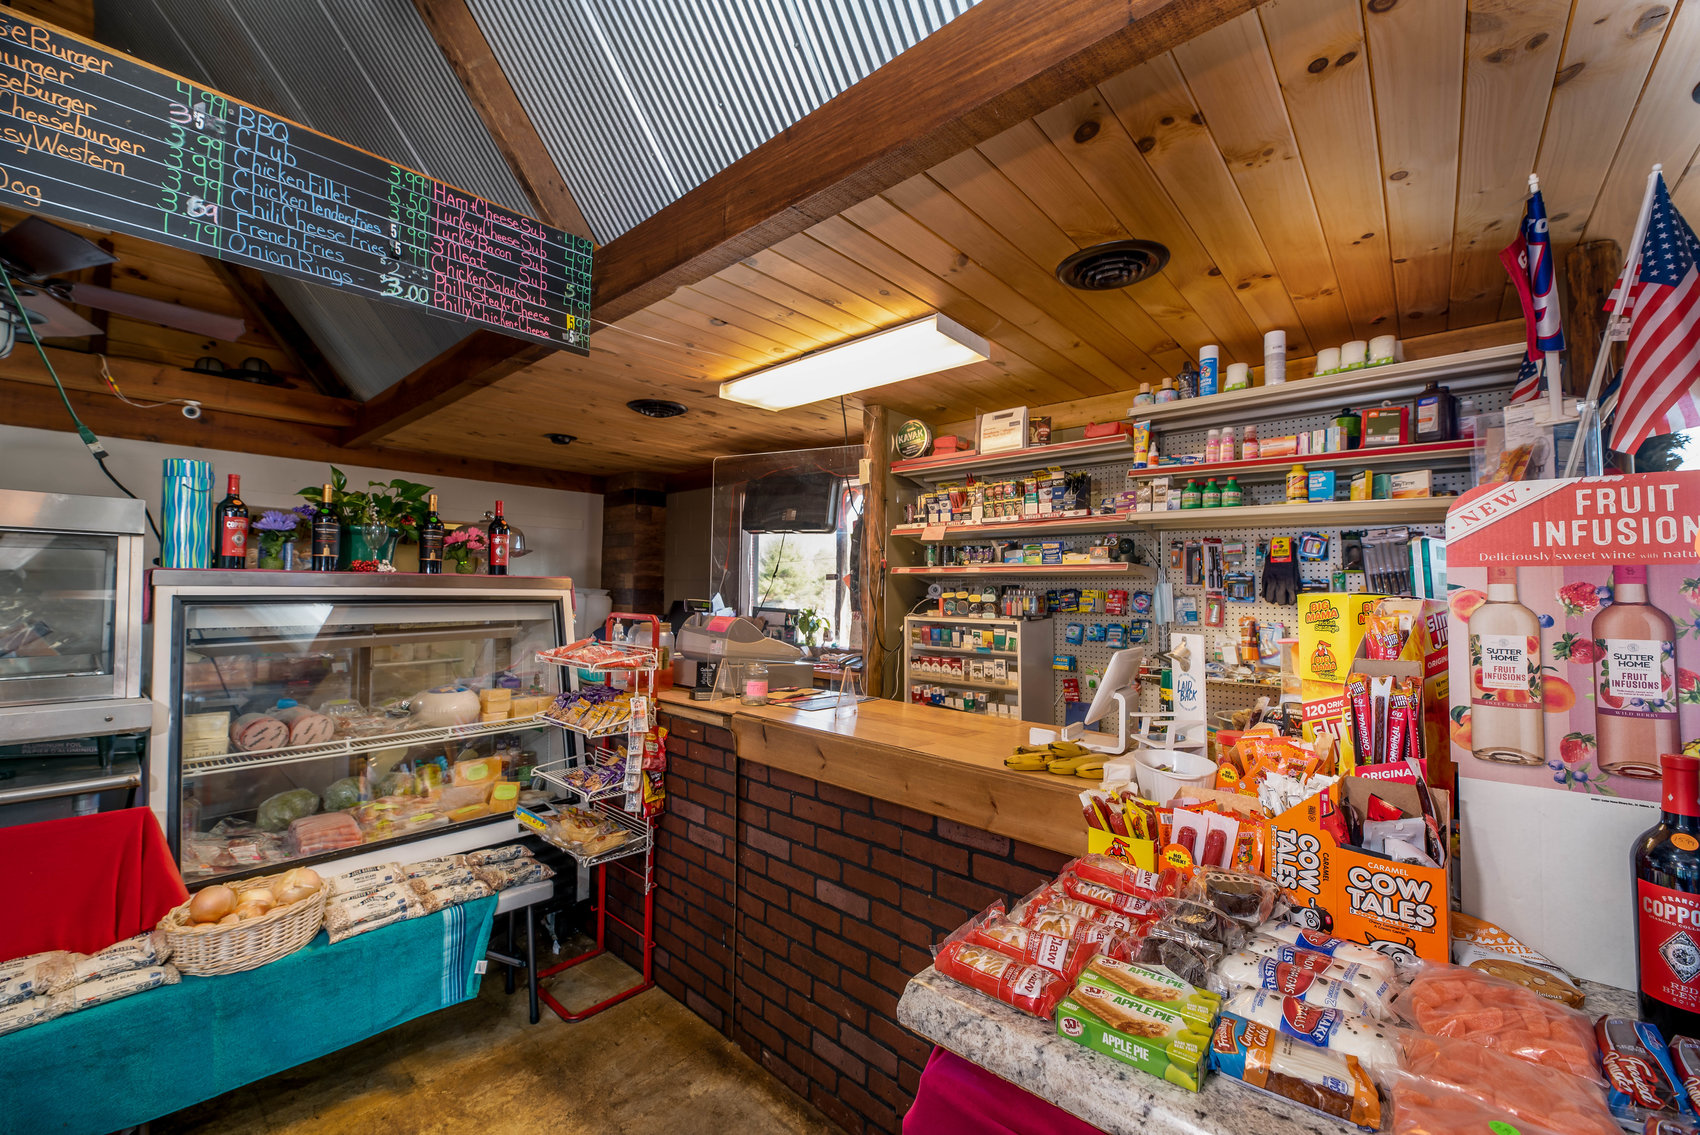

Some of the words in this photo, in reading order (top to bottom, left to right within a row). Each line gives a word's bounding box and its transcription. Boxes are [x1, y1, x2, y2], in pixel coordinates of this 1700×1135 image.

[239, 106, 289, 144] BBQ
[234, 148, 305, 192] Chicken
[388, 166, 425, 195] 3.99
[232, 169, 308, 211] Chicken
[231, 190, 280, 224] Chili
[281, 204, 347, 244] Cheese
[237, 212, 298, 249] French
[303, 233, 345, 263] Fries
[521, 219, 546, 241] Sub
[432, 218, 477, 254] Turkey
[478, 235, 512, 261] Bacon
[521, 252, 548, 273] Sub
[521, 234, 547, 258] Sub
[228, 233, 293, 268] Onion
[299, 251, 353, 287] Rings
[448, 242, 488, 270] Meat
[519, 266, 548, 290] Sub
[434, 273, 472, 300] Philly
[485, 271, 516, 296] Salad
[517, 283, 547, 307] Sub
[434, 291, 471, 323] Philly
[898, 429, 924, 445] KAYAK
[1459, 488, 1518, 527] NEW
[1575, 483, 1680, 516] FRUIT
[1479, 551, 1551, 563] Deliciously
[1555, 551, 1596, 561] sweet
[1601, 550, 1636, 560] wine
[1305, 609, 1339, 623] MAMA
[1310, 600, 1330, 612] BIG
[1363, 601, 1374, 613] BI
[1315, 655, 1330, 664] BIG
[1486, 647, 1523, 656] SUTTER
[1490, 654, 1519, 662] HOME
[1613, 652, 1654, 662] SUTTER
[1311, 662, 1337, 672] MAMA
[1494, 665, 1516, 673] FRUIT
[1618, 661, 1651, 669] HOME
[1621, 671, 1648, 681] FRUIT
[1484, 672, 1527, 682] INFUSIONS
[1611, 679, 1660, 690] INFUSIONS
[1180, 689, 1198, 702] BACK
[1305, 704, 1327, 717] 120
[1361, 711, 1371, 751] ORIGINAL
[1389, 726, 1400, 763] ORIGINAL
[1361, 767, 1415, 779] ORIGINA
[1168, 858, 1187, 866] PORK!
[1277, 829, 1298, 890] TALES
[1298, 834, 1321, 894] COW
[1367, 862, 1409, 876] CARAMEL
[1348, 866, 1432, 902] COW
[1345, 886, 1437, 927] TALES
[1661, 895, 1700, 909] FRANCI
[1128, 967, 1167, 983] APPLE
[1167, 978, 1186, 990] PIE
[1670, 981, 1699, 996] RED
[1662, 985, 1700, 1002] BLEN
[1112, 996, 1154, 1017] APPLE
[1153, 1012, 1176, 1024] PIE
[1102, 1032, 1134, 1057] APPLE
[1134, 1044, 1150, 1062] PIE
[1254, 1026, 1269, 1047] Cake
